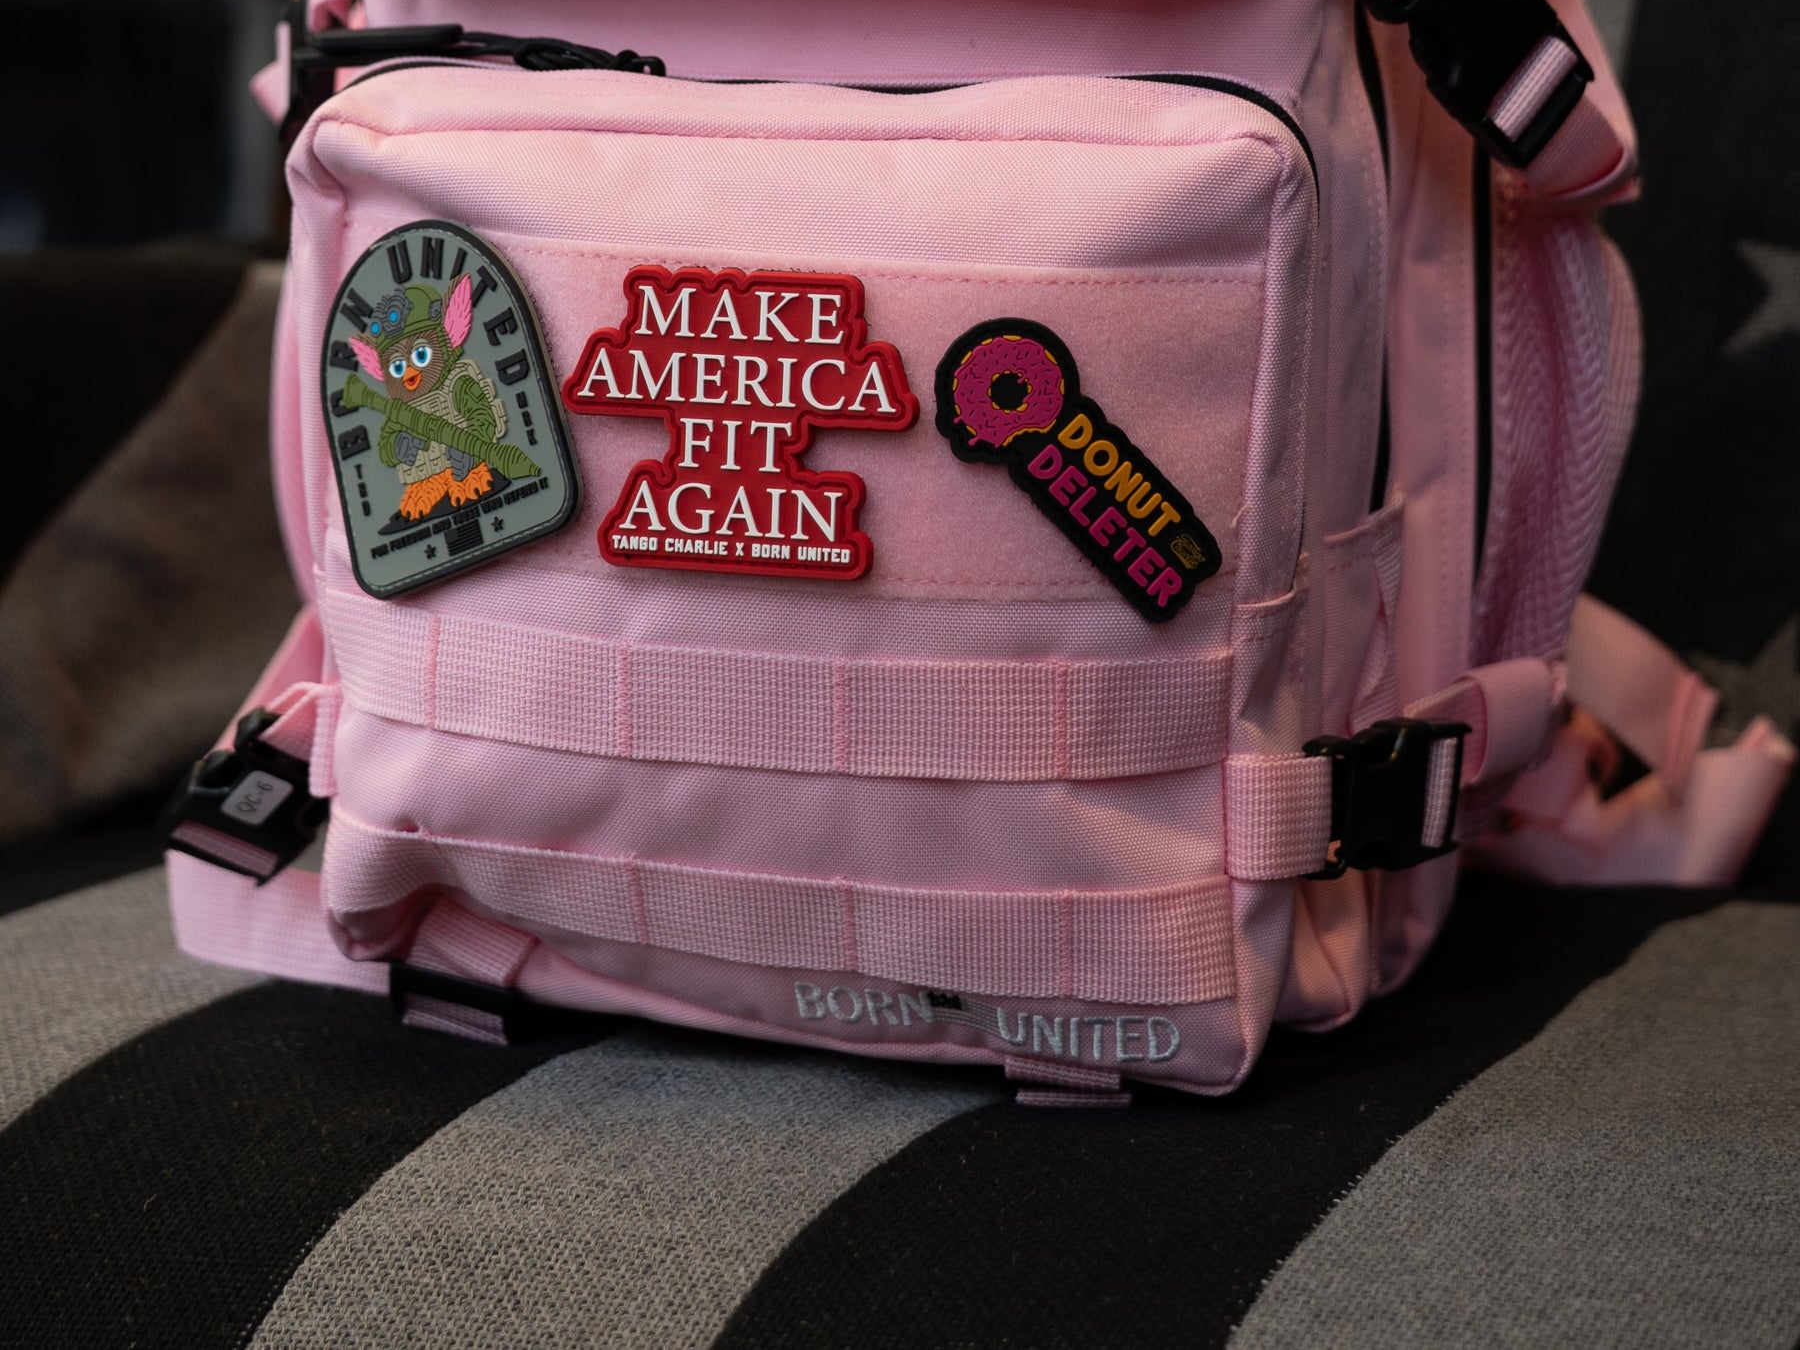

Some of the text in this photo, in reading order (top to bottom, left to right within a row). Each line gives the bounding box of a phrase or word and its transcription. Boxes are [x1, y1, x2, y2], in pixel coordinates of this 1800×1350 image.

[387, 236, 530, 386] UNITED
[635, 285, 845, 345] MAKE
[577, 348, 896, 413] AMERICA
[678, 417, 793, 473] FIT
[1058, 413, 1181, 537] DONUT
[619, 480, 843, 543] AGAIN
[1027, 444, 1183, 607] DELETER
[612, 535, 658, 551] TANGO
[665, 537, 728, 555] CHARLIE
[751, 543, 790, 559] BORN
[797, 546, 850, 564] UNITED
[794, 981, 1181, 1062] BORN UNITED
